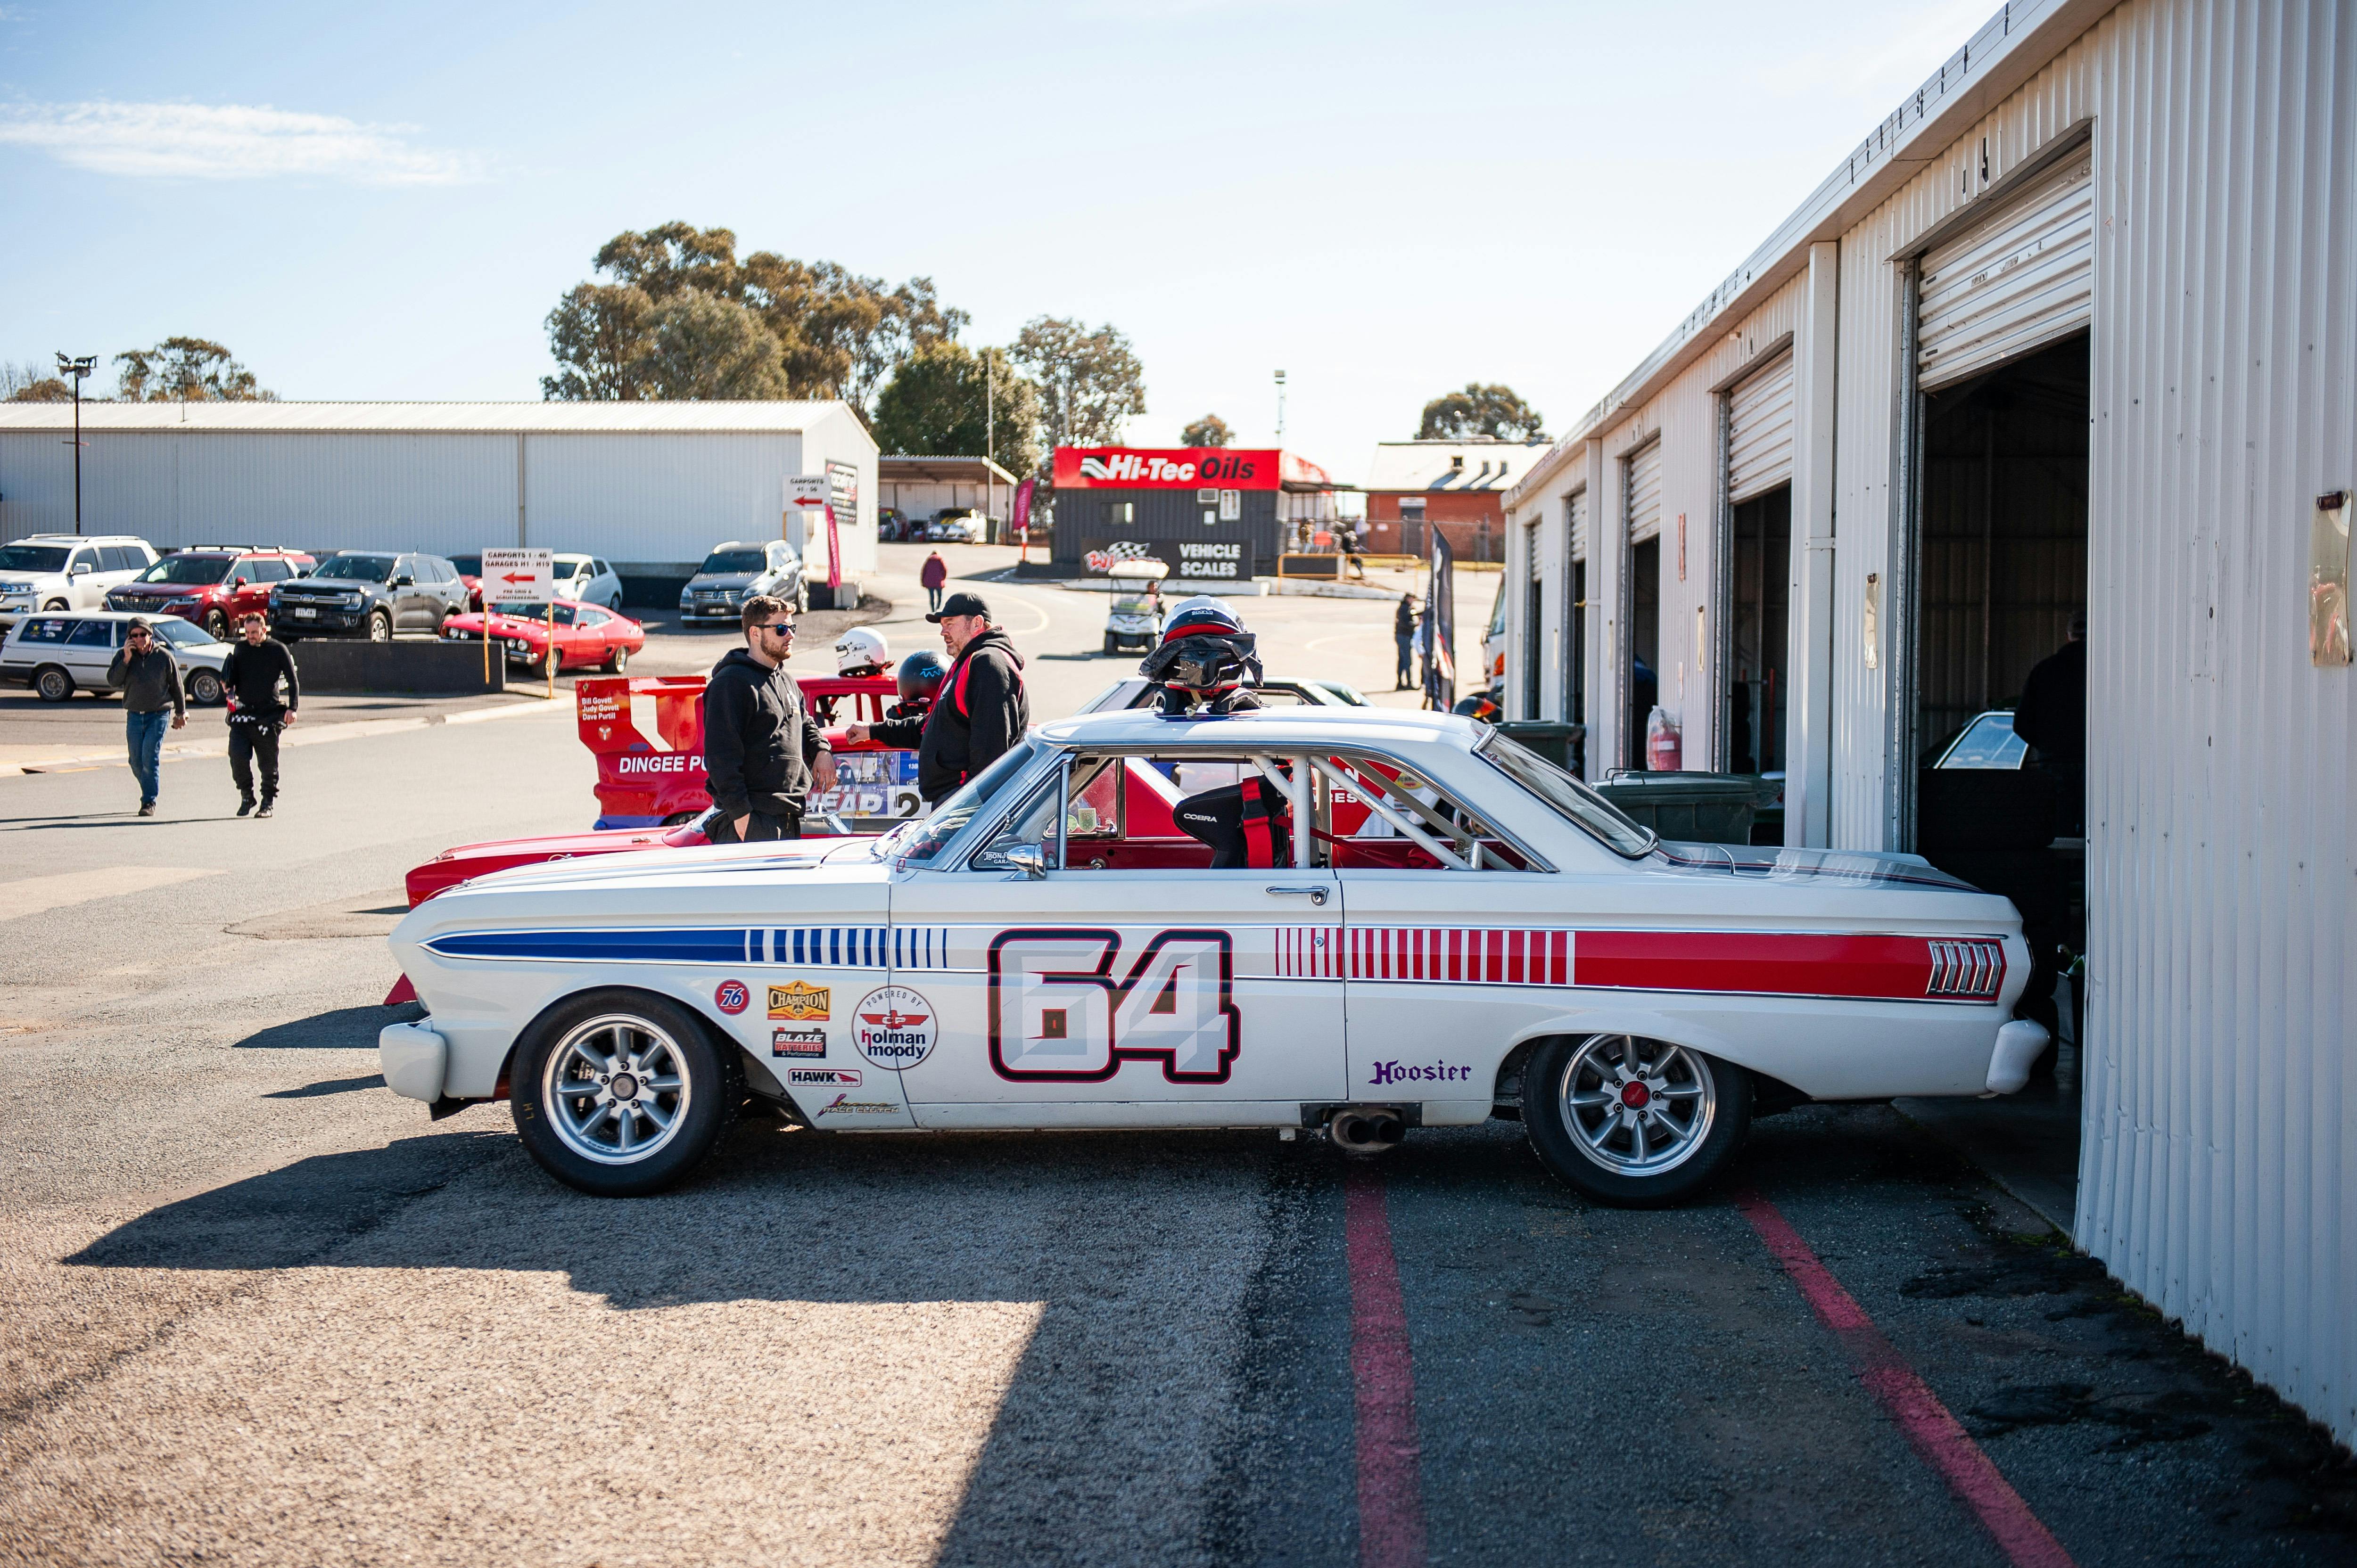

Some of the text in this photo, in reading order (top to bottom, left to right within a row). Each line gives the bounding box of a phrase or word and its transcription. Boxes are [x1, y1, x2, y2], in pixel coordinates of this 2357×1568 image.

[1107, 454, 1254, 481] Hi-Tec Oils
[1179, 543, 1241, 559] VEHICLE
[1180, 562, 1237, 576] SCALES
[598, 712, 616, 720] Purtill
[619, 755, 685, 773] DINGEE
[1183, 813, 1217, 822] COBRA
[720, 988, 744, 1007] 76
[769, 990, 828, 1010] CHAMPION
[866, 991, 922, 1007] POWERED BY
[988, 928, 1241, 1084] 64
[775, 1034, 824, 1043] BLAZE
[861, 1029, 925, 1044] holman
[867, 1044, 926, 1059] moody
[791, 1071, 836, 1082] HAWK
[1368, 1059, 1472, 1084] Hoosier
